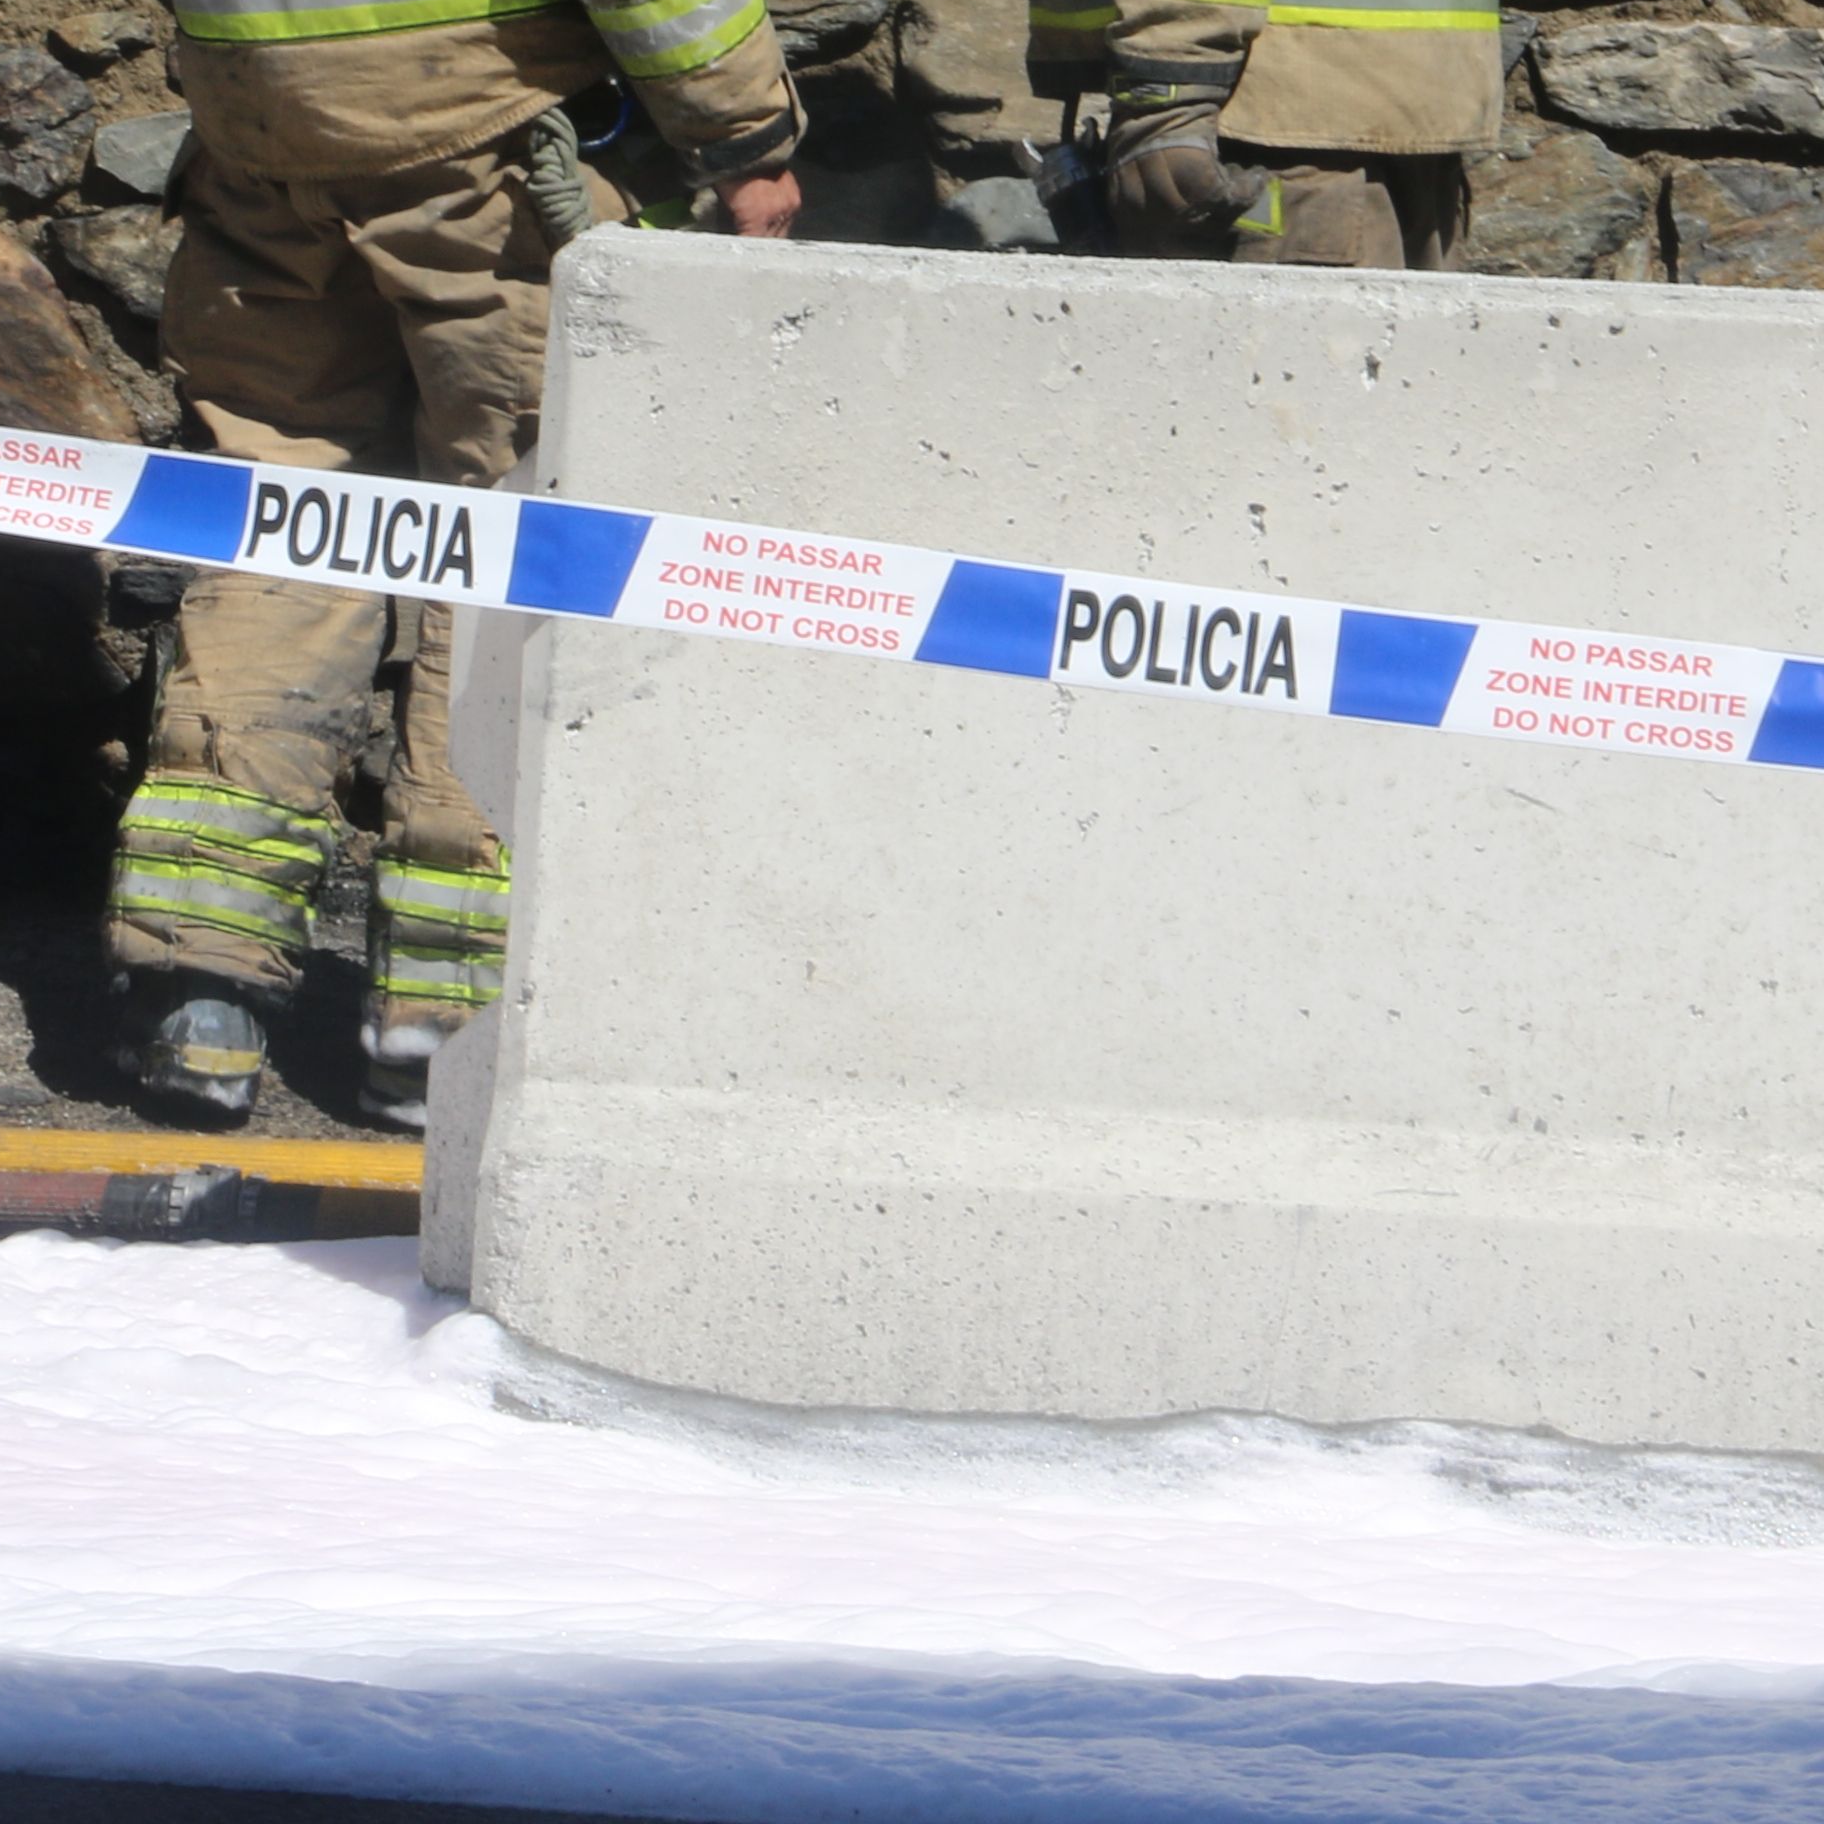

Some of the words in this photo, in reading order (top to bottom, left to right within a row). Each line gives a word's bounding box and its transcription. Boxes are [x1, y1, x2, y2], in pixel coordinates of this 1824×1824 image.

[245, 482, 474, 589] POLICIA
[702, 531, 748, 556] NO
[758, 538, 883, 575] PASSAR
[658, 561, 744, 592] ZONE
[753, 574, 915, 616] INTERDITE
[664, 598, 709, 623] DO
[719, 606, 784, 634] NOT
[793, 617, 900, 651] CROSS
[1058, 588, 1298, 700] POLICIA
[1530, 638, 1575, 662] NO
[1586, 644, 1713, 677] PASSAR
[1486, 669, 1573, 699] ZONE
[1583, 680, 1747, 718] INTERDITE
[1493, 707, 1538, 731] DO
[1549, 713, 1615, 739] NOT
[1625, 722, 1734, 752] CROSS
